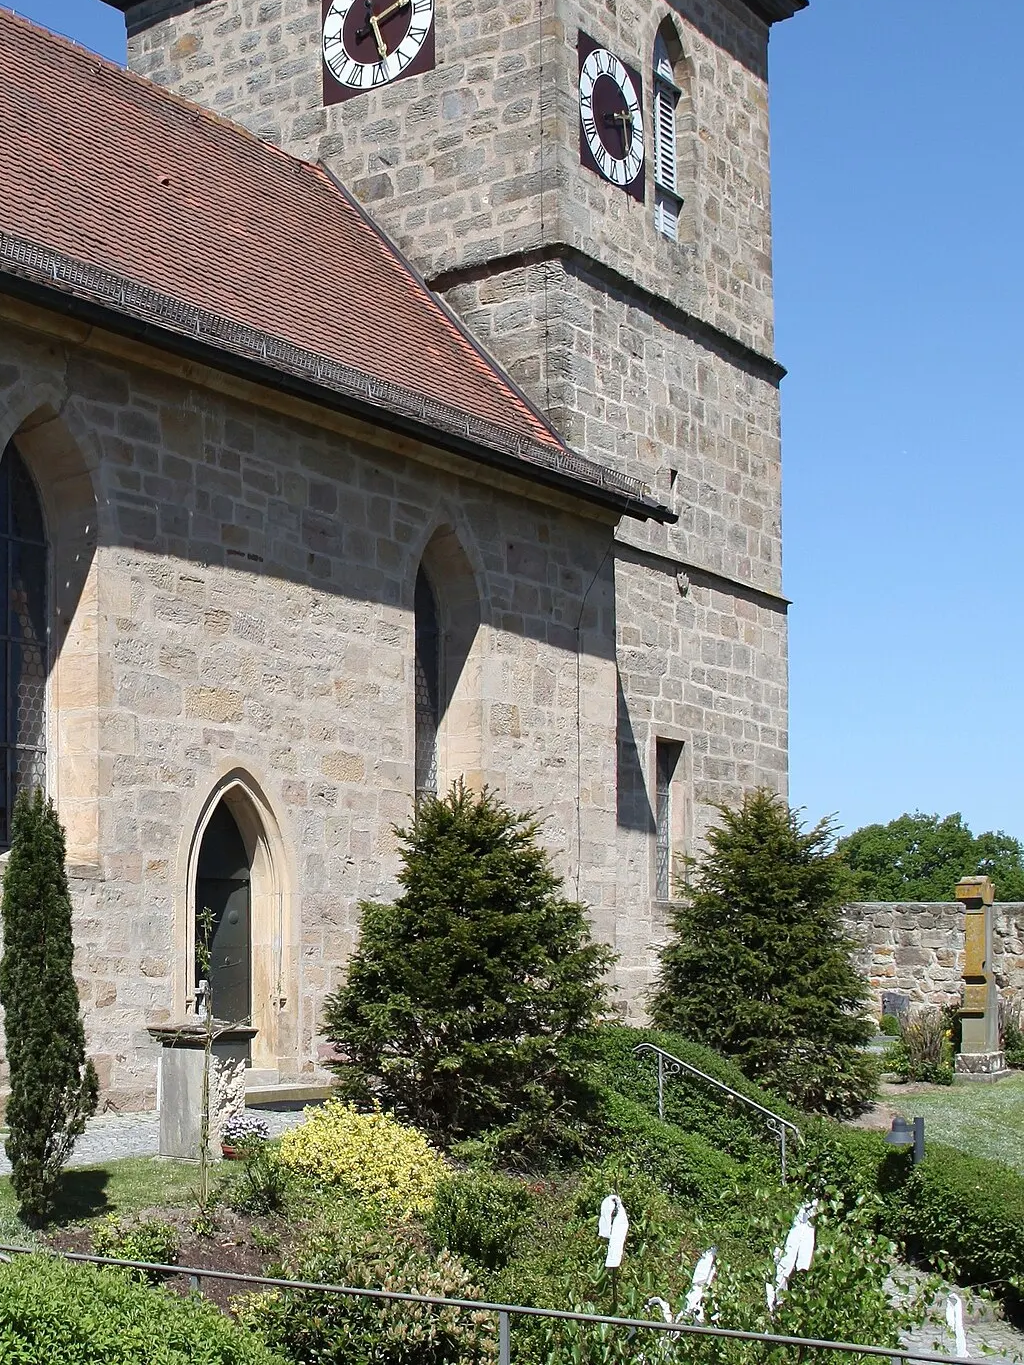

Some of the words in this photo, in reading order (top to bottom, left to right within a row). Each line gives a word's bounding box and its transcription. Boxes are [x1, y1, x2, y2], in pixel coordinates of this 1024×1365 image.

[328, 5, 348, 19] X
[324, 28, 342, 51] IX
[406, 26, 427, 46] IV
[328, 48, 349, 78] VIII
[396, 48, 412, 71] V
[346, 64, 364, 86] VII
[371, 62, 386, 86] VI
